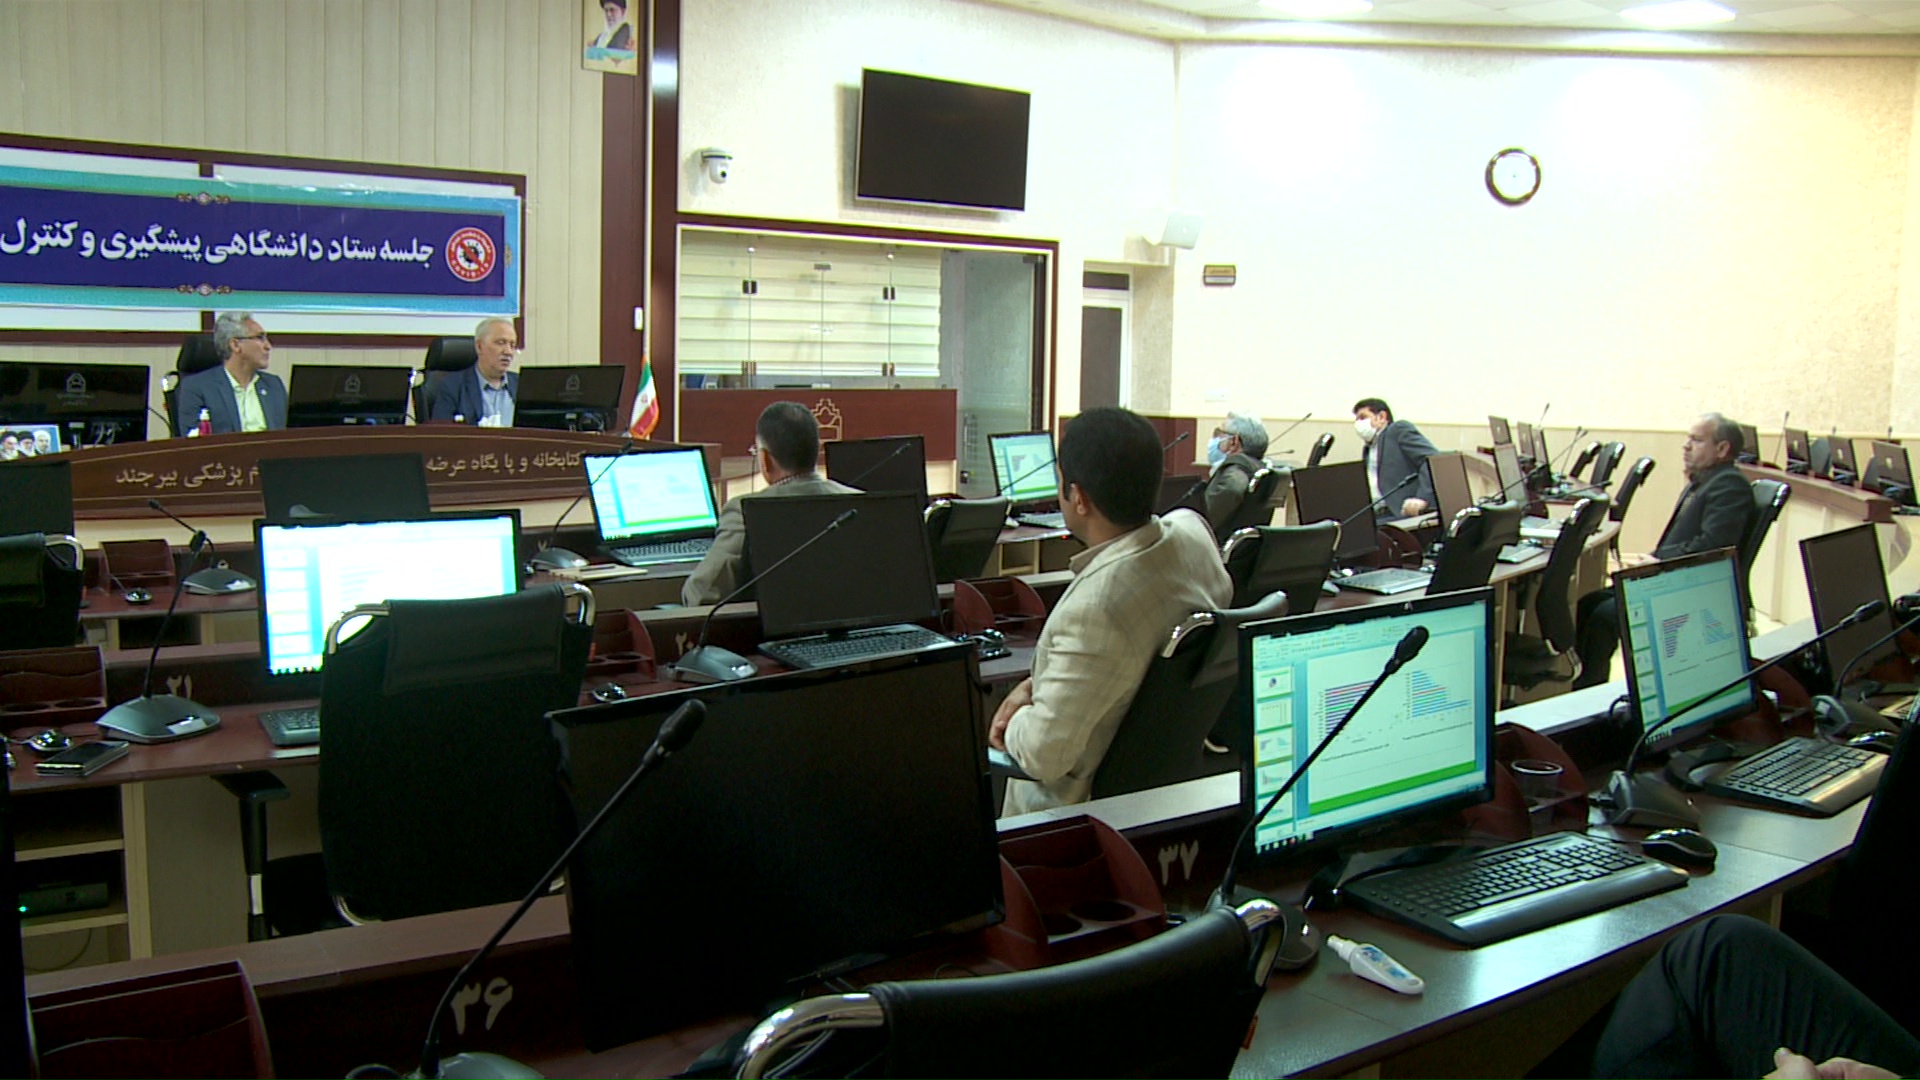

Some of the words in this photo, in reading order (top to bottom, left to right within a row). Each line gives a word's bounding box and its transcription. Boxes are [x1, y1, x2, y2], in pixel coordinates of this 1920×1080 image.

[0, 217, 78, 255] کنترل
[79, 230, 96, 258] و
[100, 223, 202, 262] پیشگیری
[204, 229, 324, 264] دانشگاهی
[328, 235, 376, 262] ستاد
[380, 237, 434, 269] جلسه
[426, 453, 466, 477] عرضه
[519, 456, 528, 472] و
[532, 450, 586, 468] کتابخانه
[116, 467, 178, 489] بیرجند
[184, 462, 242, 488] پزشکی
[1158, 839, 1199, 886] ۳۷
[450, 976, 514, 1036] ۳۶
